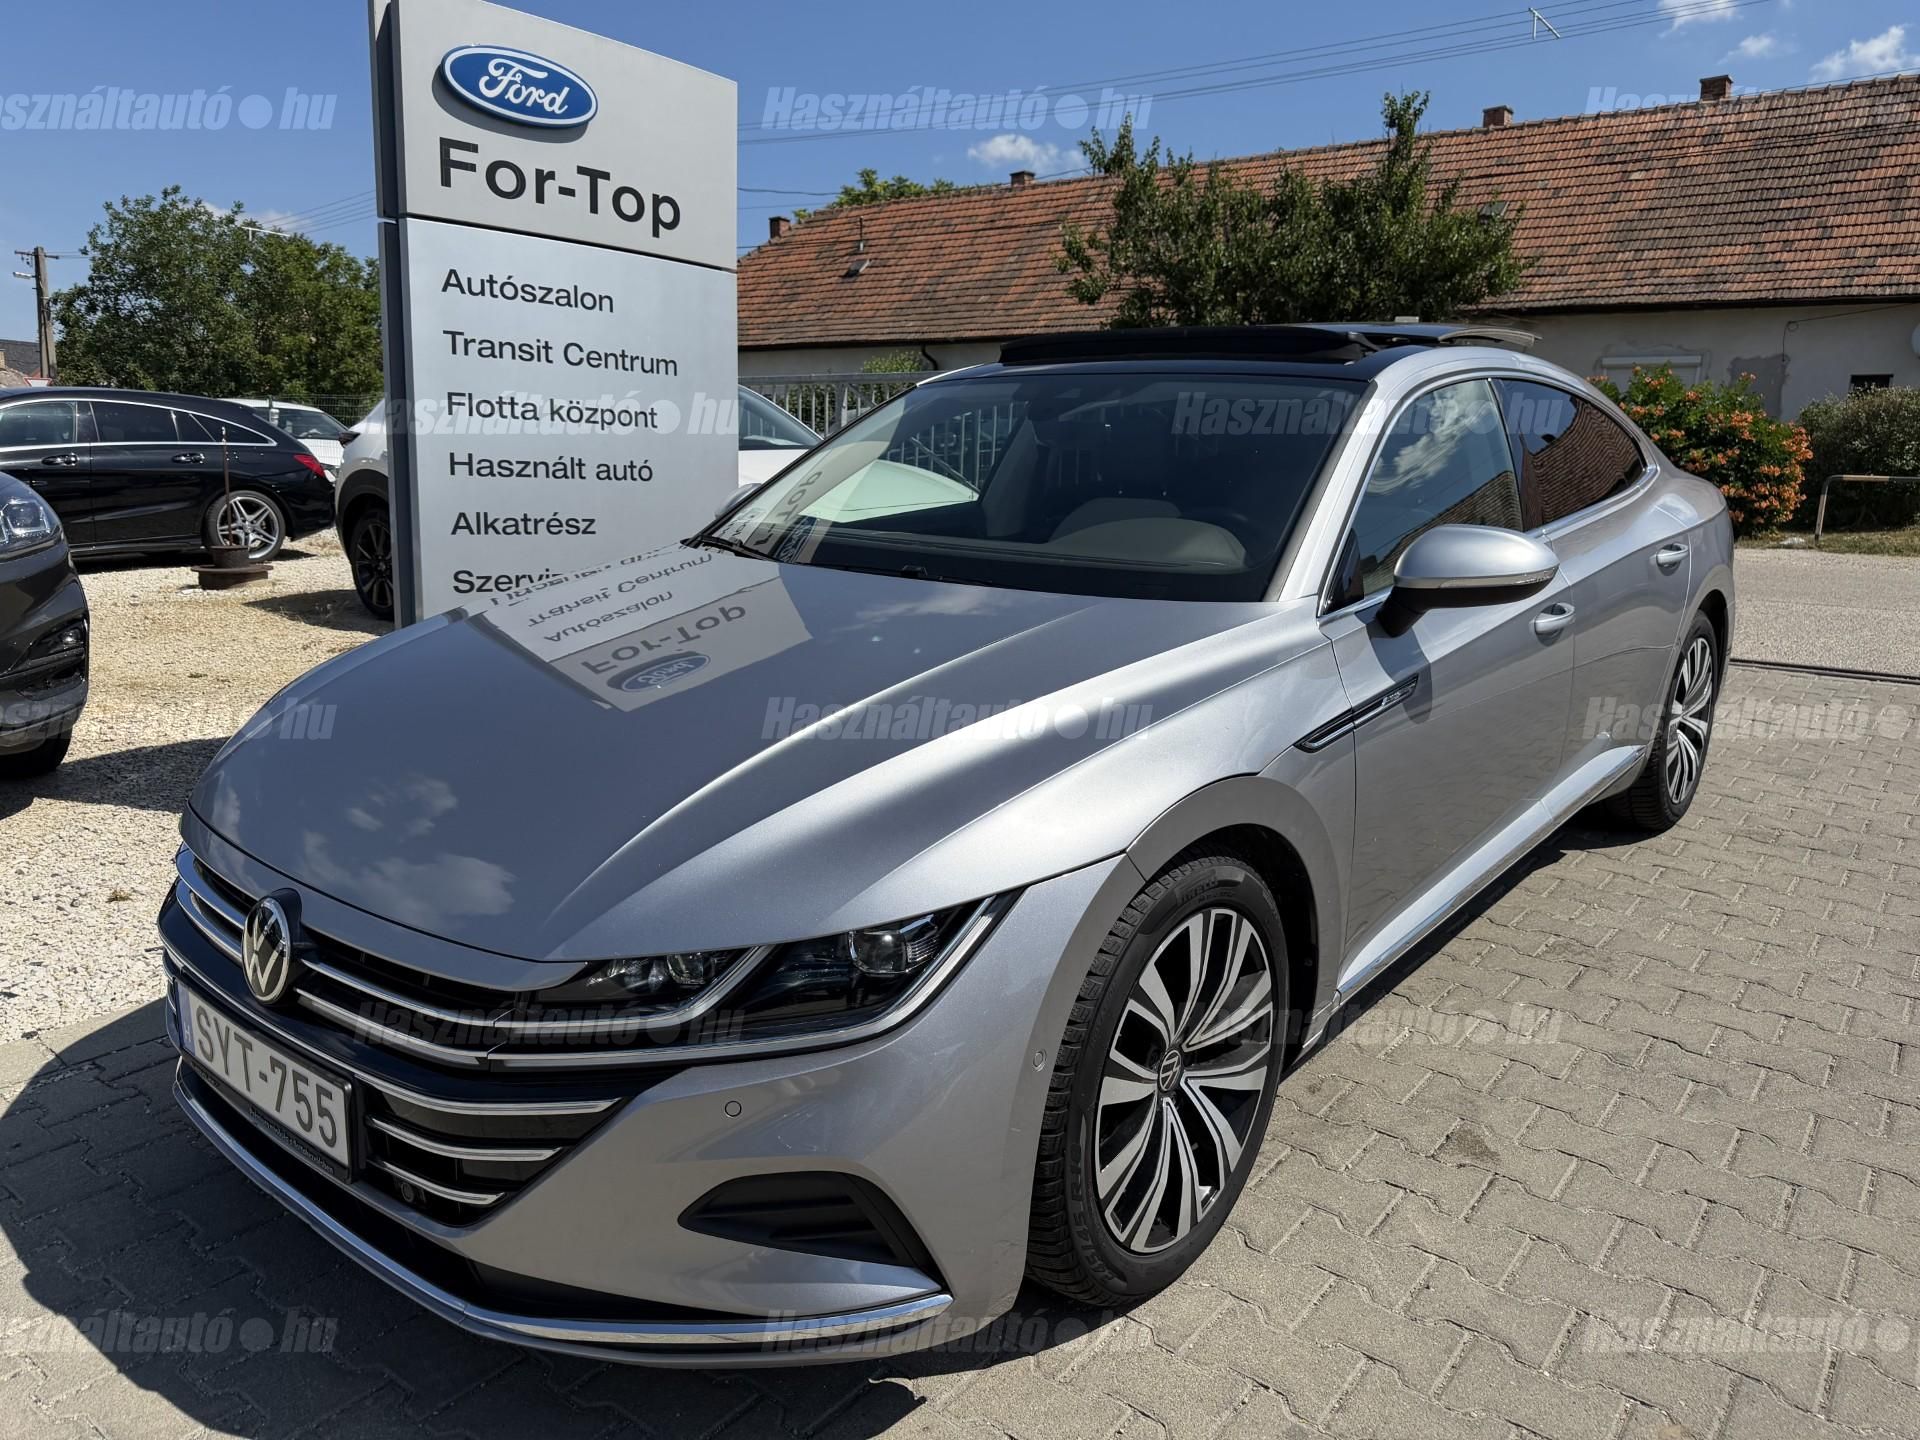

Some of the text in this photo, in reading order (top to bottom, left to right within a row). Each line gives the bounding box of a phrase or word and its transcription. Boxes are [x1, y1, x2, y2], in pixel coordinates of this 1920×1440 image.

[479, 58, 570, 115] Ford
[439, 136, 681, 238] For-Top
[441, 268, 614, 313] Autószalon
[442, 330, 679, 376] Transit Centrum
[446, 391, 658, 431] Flotta központ
[449, 452, 653, 482] Használt autó
[451, 511, 597, 536] Alkatrész
[196, 1005, 338, 1149] SYT-755
